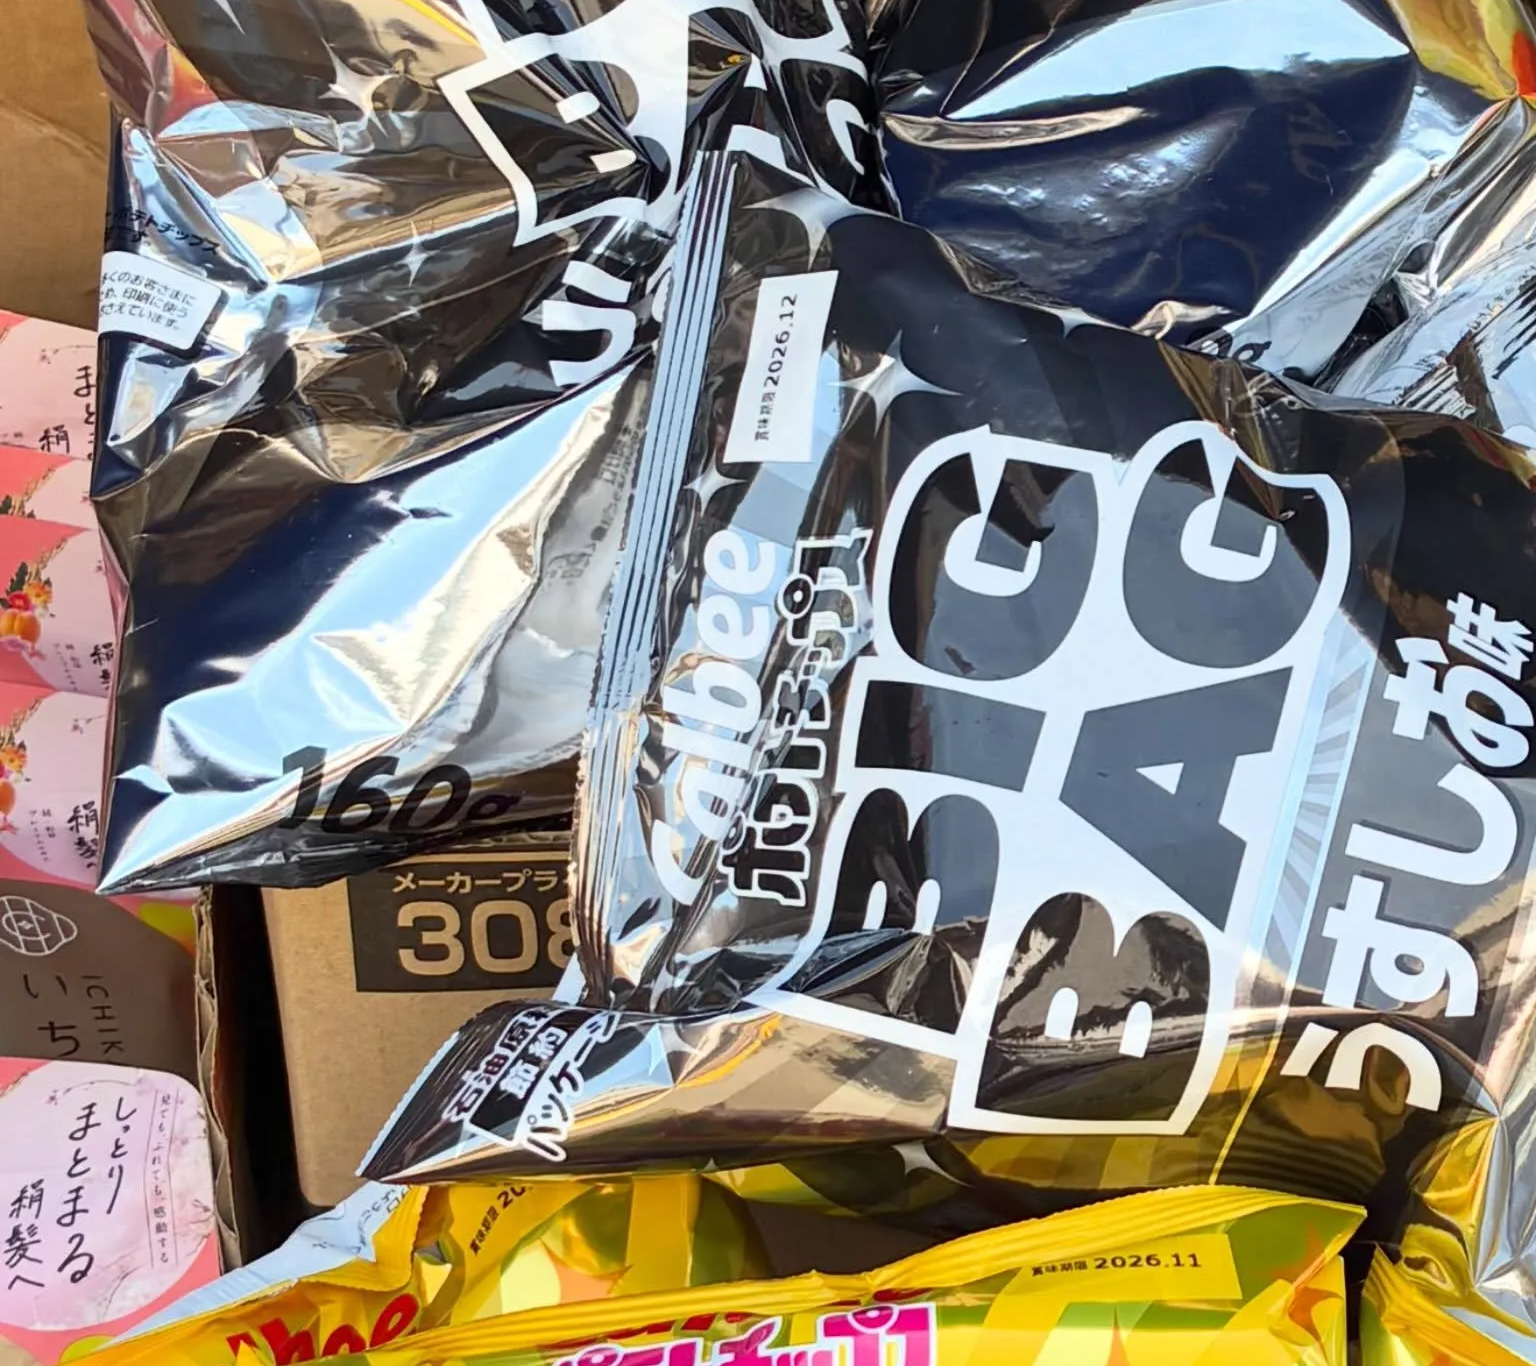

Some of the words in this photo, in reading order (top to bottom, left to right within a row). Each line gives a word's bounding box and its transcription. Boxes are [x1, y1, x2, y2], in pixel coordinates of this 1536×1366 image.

[763, 292, 799, 388] 2026.12
[652, 529, 774, 909] Calbee
[785, 449, 1100, 1037] BIG
[972, 435, 1334, 1123] BAG
[1280, 590, 1535, 1114] うすしお味
[397, 902, 579, 977] 308
[23, 972, 80, 1059] いち
[82, 974, 126, 1056] ICHIK
[499, 1025, 570, 1102] 節約
[521, 1008, 618, 1161] パッケージ
[55, 1101, 103, 1285] まとまる
[106, 1096, 138, 1215] しっとり
[3, 1177, 45, 1292] 絹髪へ
[1092, 1250, 1203, 1272] 2026.11
